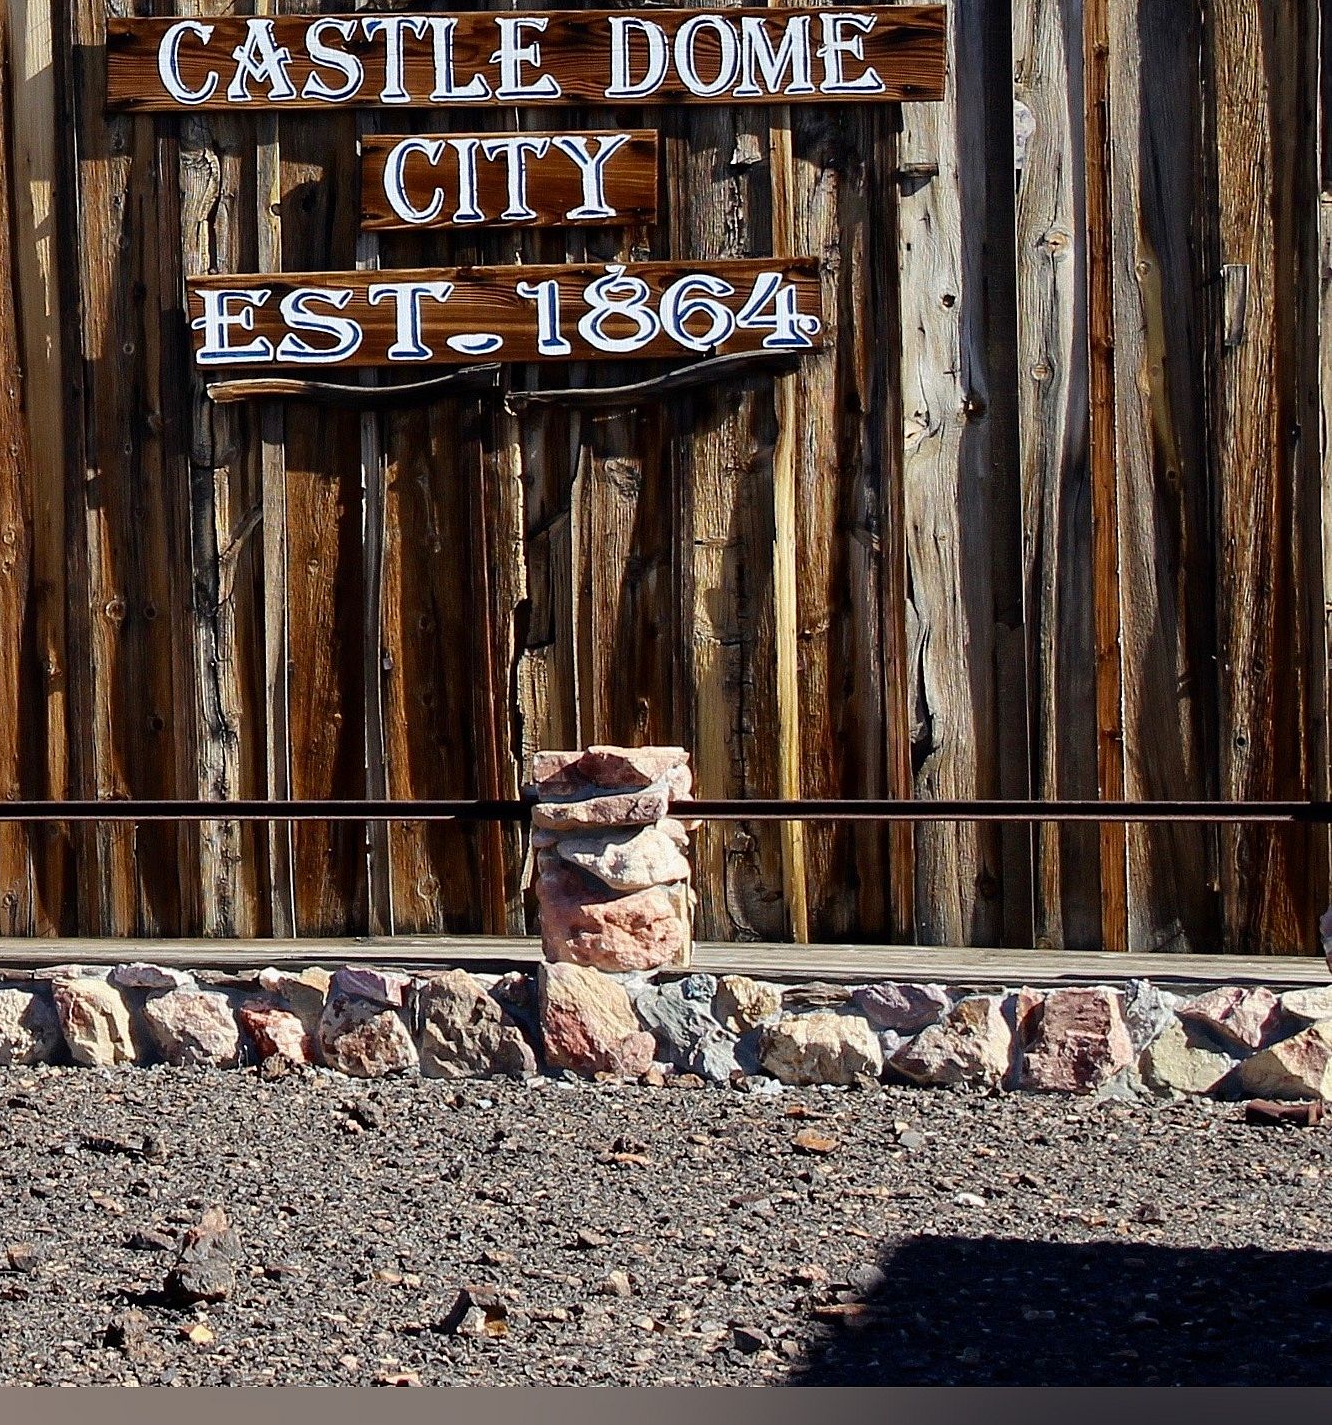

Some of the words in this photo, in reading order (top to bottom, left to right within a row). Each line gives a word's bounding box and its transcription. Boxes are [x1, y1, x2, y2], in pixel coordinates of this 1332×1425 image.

[156, 14, 560, 105] CASTLE
[606, 10, 887, 99] DOME
[382, 134, 631, 223] CITY
[191, 281, 504, 364] EST.
[516, 264, 821, 359] 1864
